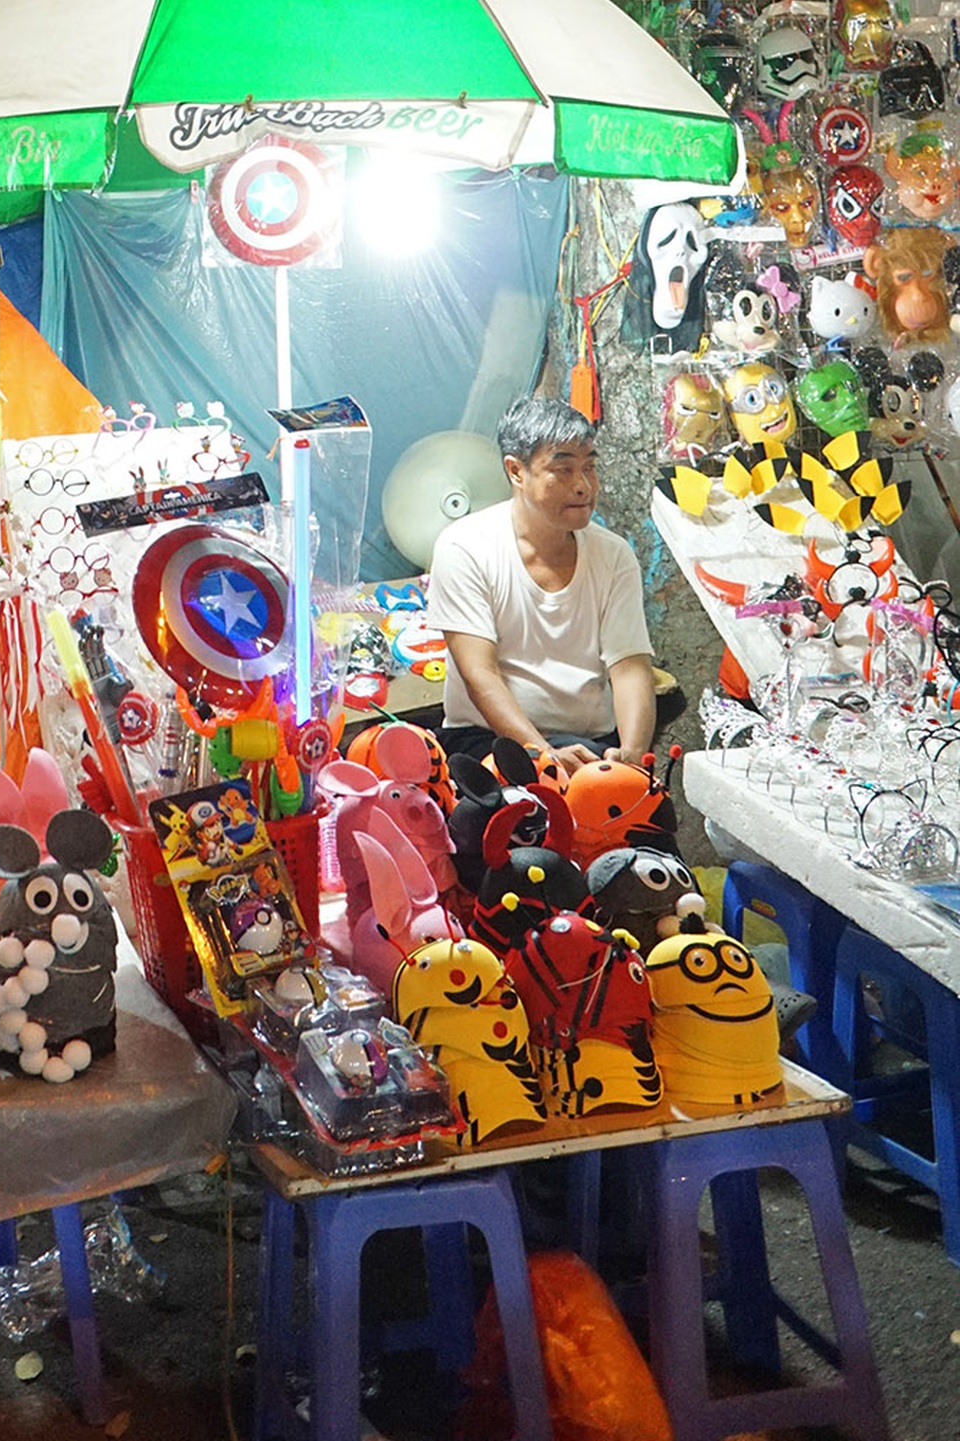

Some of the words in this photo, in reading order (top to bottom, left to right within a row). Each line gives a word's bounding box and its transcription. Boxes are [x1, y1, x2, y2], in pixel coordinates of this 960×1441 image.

[5, 125, 62, 164] Bia
[128, 496, 173, 515] CAPTAIN
[174, 491, 222, 508] AMERICA
